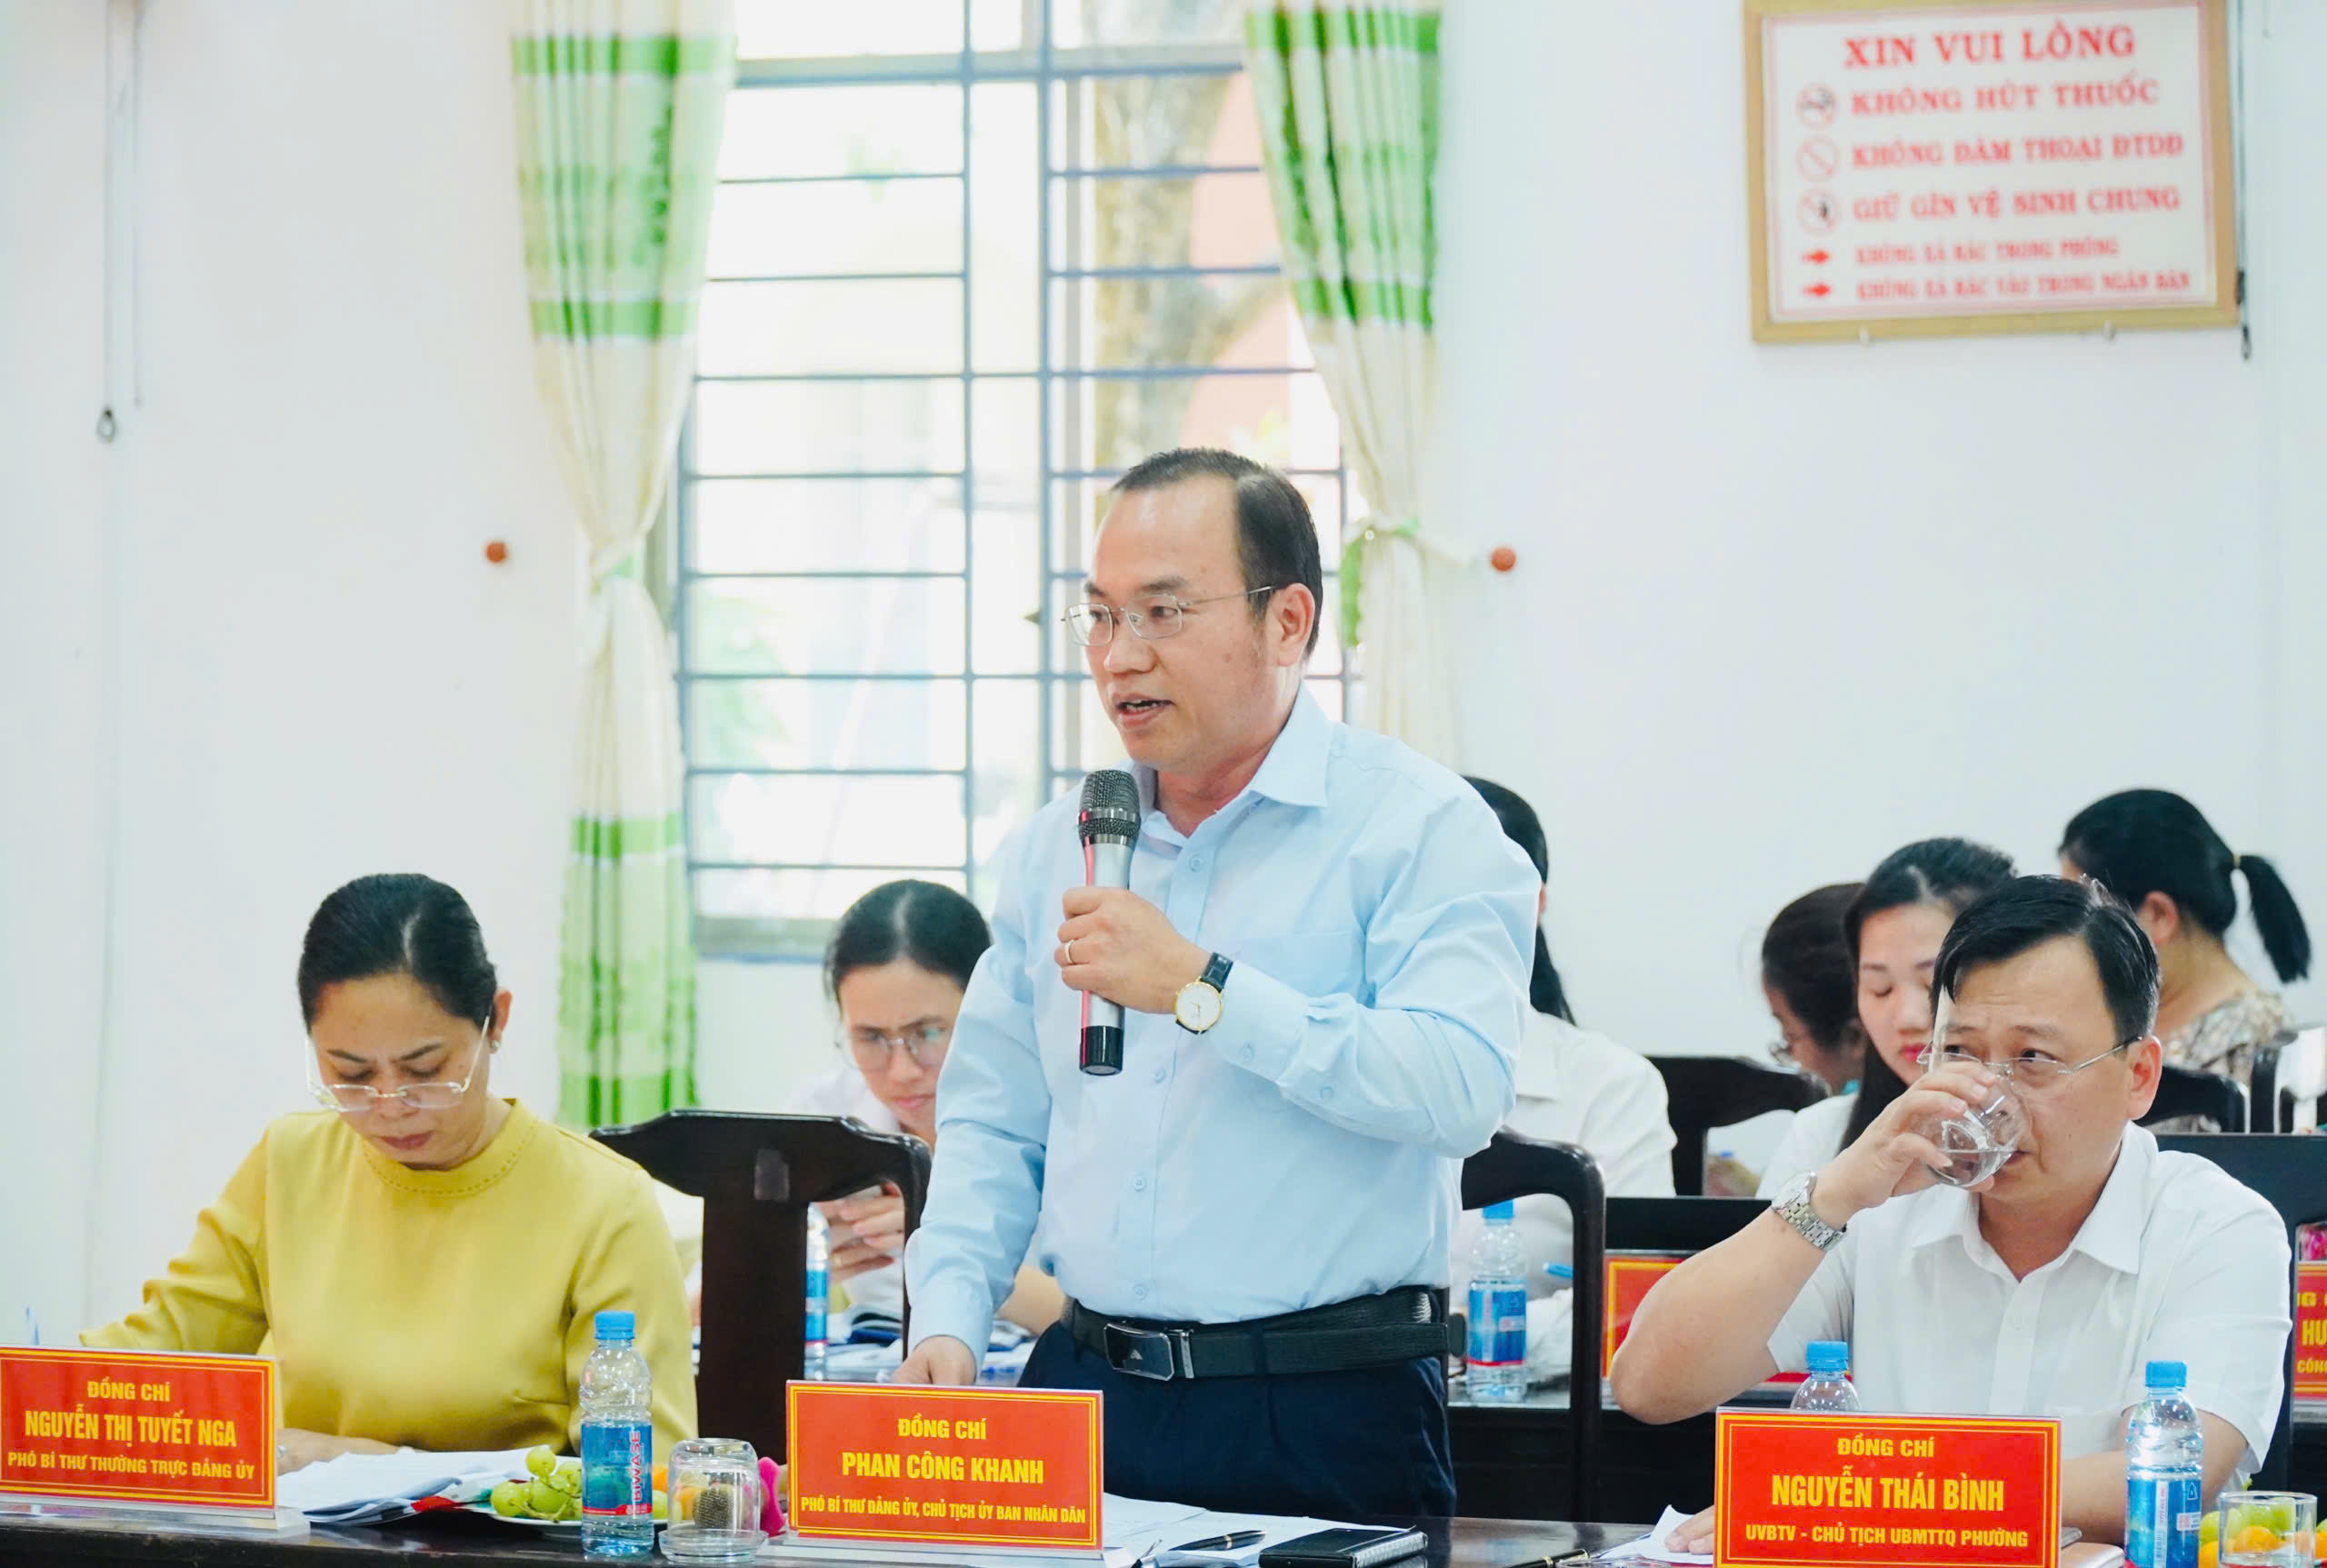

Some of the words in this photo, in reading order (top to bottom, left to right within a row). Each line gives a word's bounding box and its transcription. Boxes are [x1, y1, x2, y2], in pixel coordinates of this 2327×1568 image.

[1844, 36, 1915, 68] XIN
[1934, 30, 2002, 65] VUI
[1852, 84, 1962, 115] KHÔNG
[2054, 70, 2159, 106] THUỐC
[1853, 137, 1943, 167] KHÔNG
[141, 1381, 170, 1402] CHÍ
[25, 1403, 99, 1440] NGUYỄN
[104, 1415, 133, 1447] THỊ
[138, 1410, 193, 1444] TUYẾT
[198, 1421, 236, 1447] NGA
[898, 1413, 949, 1439] ĐỒNG
[955, 1418, 986, 1441] CHÍ
[1837, 1433, 1893, 1457] ĐỒNG
[1900, 1437, 1934, 1458] CHÍ
[8, 1450, 36, 1468] PHÓ
[41, 1453, 55, 1468] BÍ
[59, 1454, 86, 1470] THƯ
[89, 1454, 147, 1473] THƯỜNG
[151, 1459, 187, 1478] TRỰC
[192, 1457, 232, 1479] ĐẢNG
[236, 1460, 255, 1480] ỦY
[630, 1431, 642, 1502] BIWASE
[842, 1452, 900, 1479] PHAN
[907, 1451, 964, 1481] CÔNG
[971, 1457, 1044, 1483] KHANH
[1772, 1464, 1872, 1508] NGUYỄN
[1880, 1472, 1934, 1510] THÁI
[1943, 1473, 2004, 1511] BÌNH
[801, 1493, 824, 1513] PHÓ
[828, 1495, 840, 1513] BÍ
[844, 1498, 866, 1513] THƯ
[868, 1494, 899, 1516] ĐẢNG
[903, 1496, 920, 1518] ỦY,
[923, 1498, 946, 1517] CHỦ
[949, 1503, 975, 1523] TỊCH
[978, 1500, 994, 1519] ỦY
[996, 1505, 1021, 1521] BAN
[1024, 1503, 1057, 1523] NHÂN
[1061, 1504, 1085, 1523] DÂN
[1746, 1524, 1796, 1541] UVBTV
[1812, 1522, 1845, 1543] CHỦ
[1850, 1526, 1885, 1546] TỊCH
[1891, 1528, 1956, 1547] UBMTTQ
[1961, 1527, 2028, 1547] PHƯỜNG
